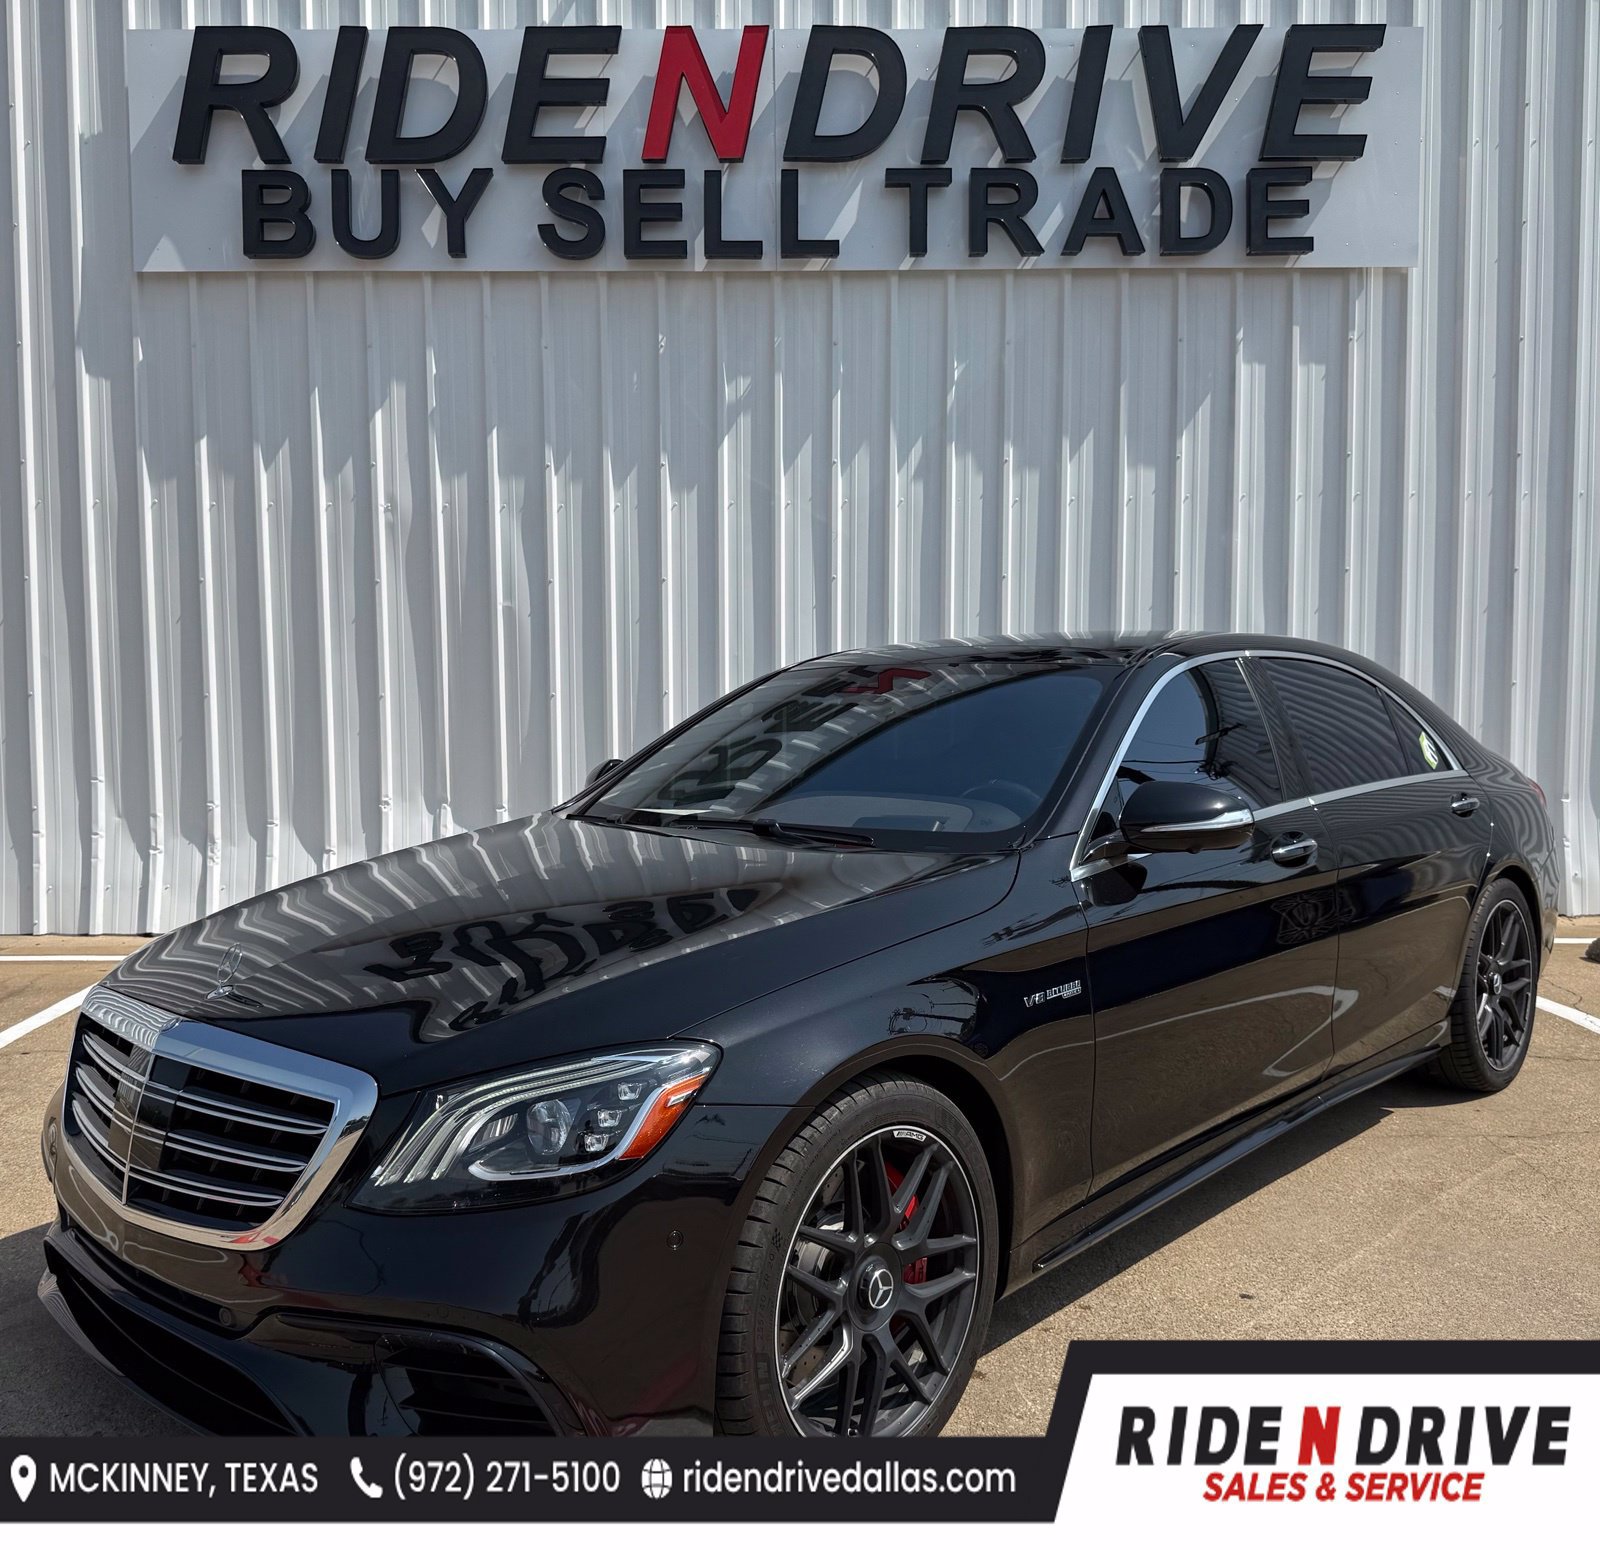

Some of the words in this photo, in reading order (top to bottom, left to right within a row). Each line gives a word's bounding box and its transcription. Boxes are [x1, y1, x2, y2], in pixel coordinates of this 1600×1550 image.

[241, 168, 493, 260] BUY
[537, 167, 840, 260] SELL
[885, 167, 1314, 258] TRADE
